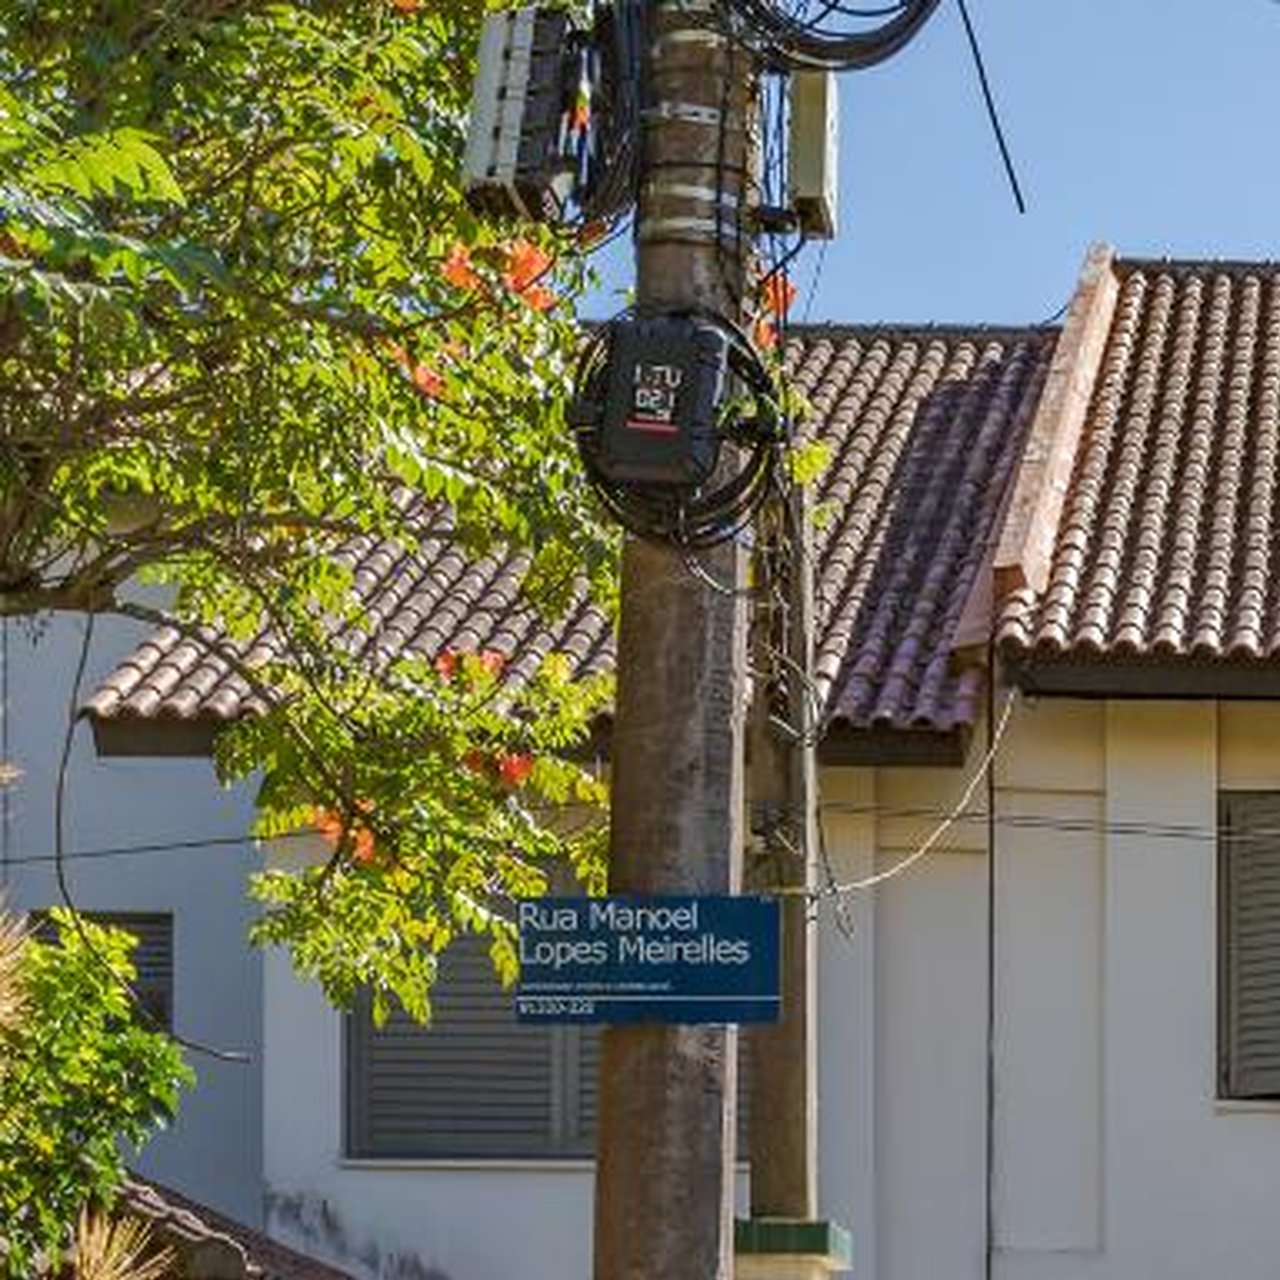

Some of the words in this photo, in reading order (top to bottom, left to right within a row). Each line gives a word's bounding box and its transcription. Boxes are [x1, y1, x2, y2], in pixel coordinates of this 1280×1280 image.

[519, 903, 577, 931] Rua
[589, 903, 698, 931] Manoel
[519, 937, 607, 969] Lopes
[618, 935, 749, 964] Meirelles
